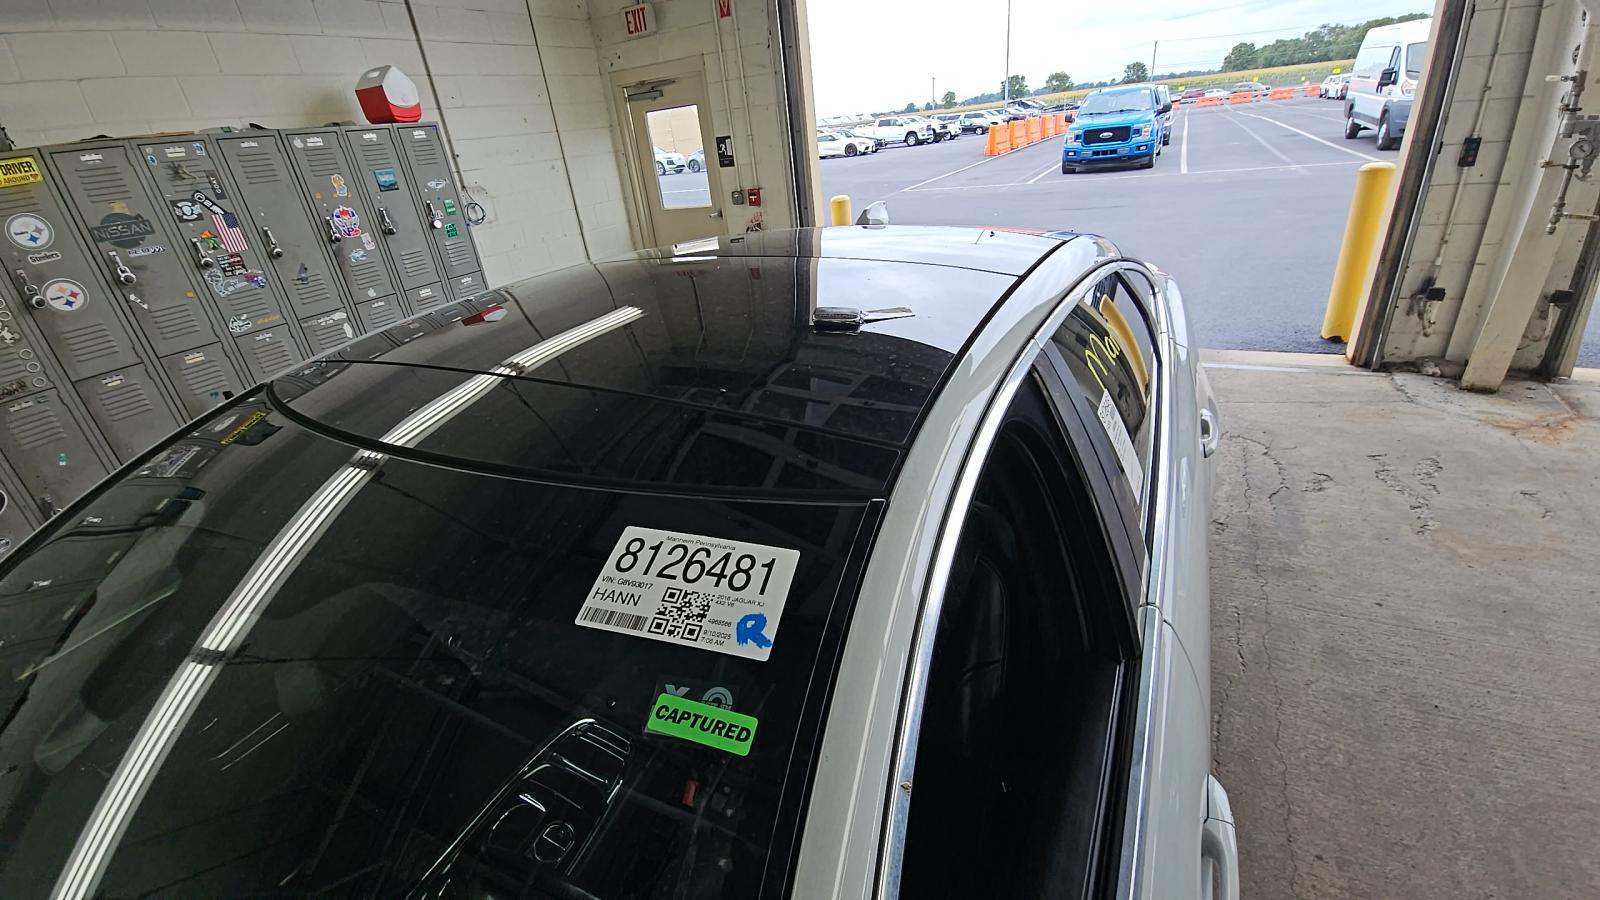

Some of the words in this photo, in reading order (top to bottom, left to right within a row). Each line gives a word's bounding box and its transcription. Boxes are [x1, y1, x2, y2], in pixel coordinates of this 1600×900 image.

[624, 7, 648, 35] EXIT
[0, 161, 36, 176] DRIVER
[93, 222, 152, 240] NISSAN
[695, 539, 737, 551] Pennsylvania
[615, 537, 777, 596] 8126481
[602, 575, 616, 585] VIN:
[592, 587, 642, 607] HANN
[732, 597, 758, 606] JAGUAR
[736, 612, 773, 649] R
[713, 639, 725, 647] AM
[655, 704, 752, 743] CAPTURED
